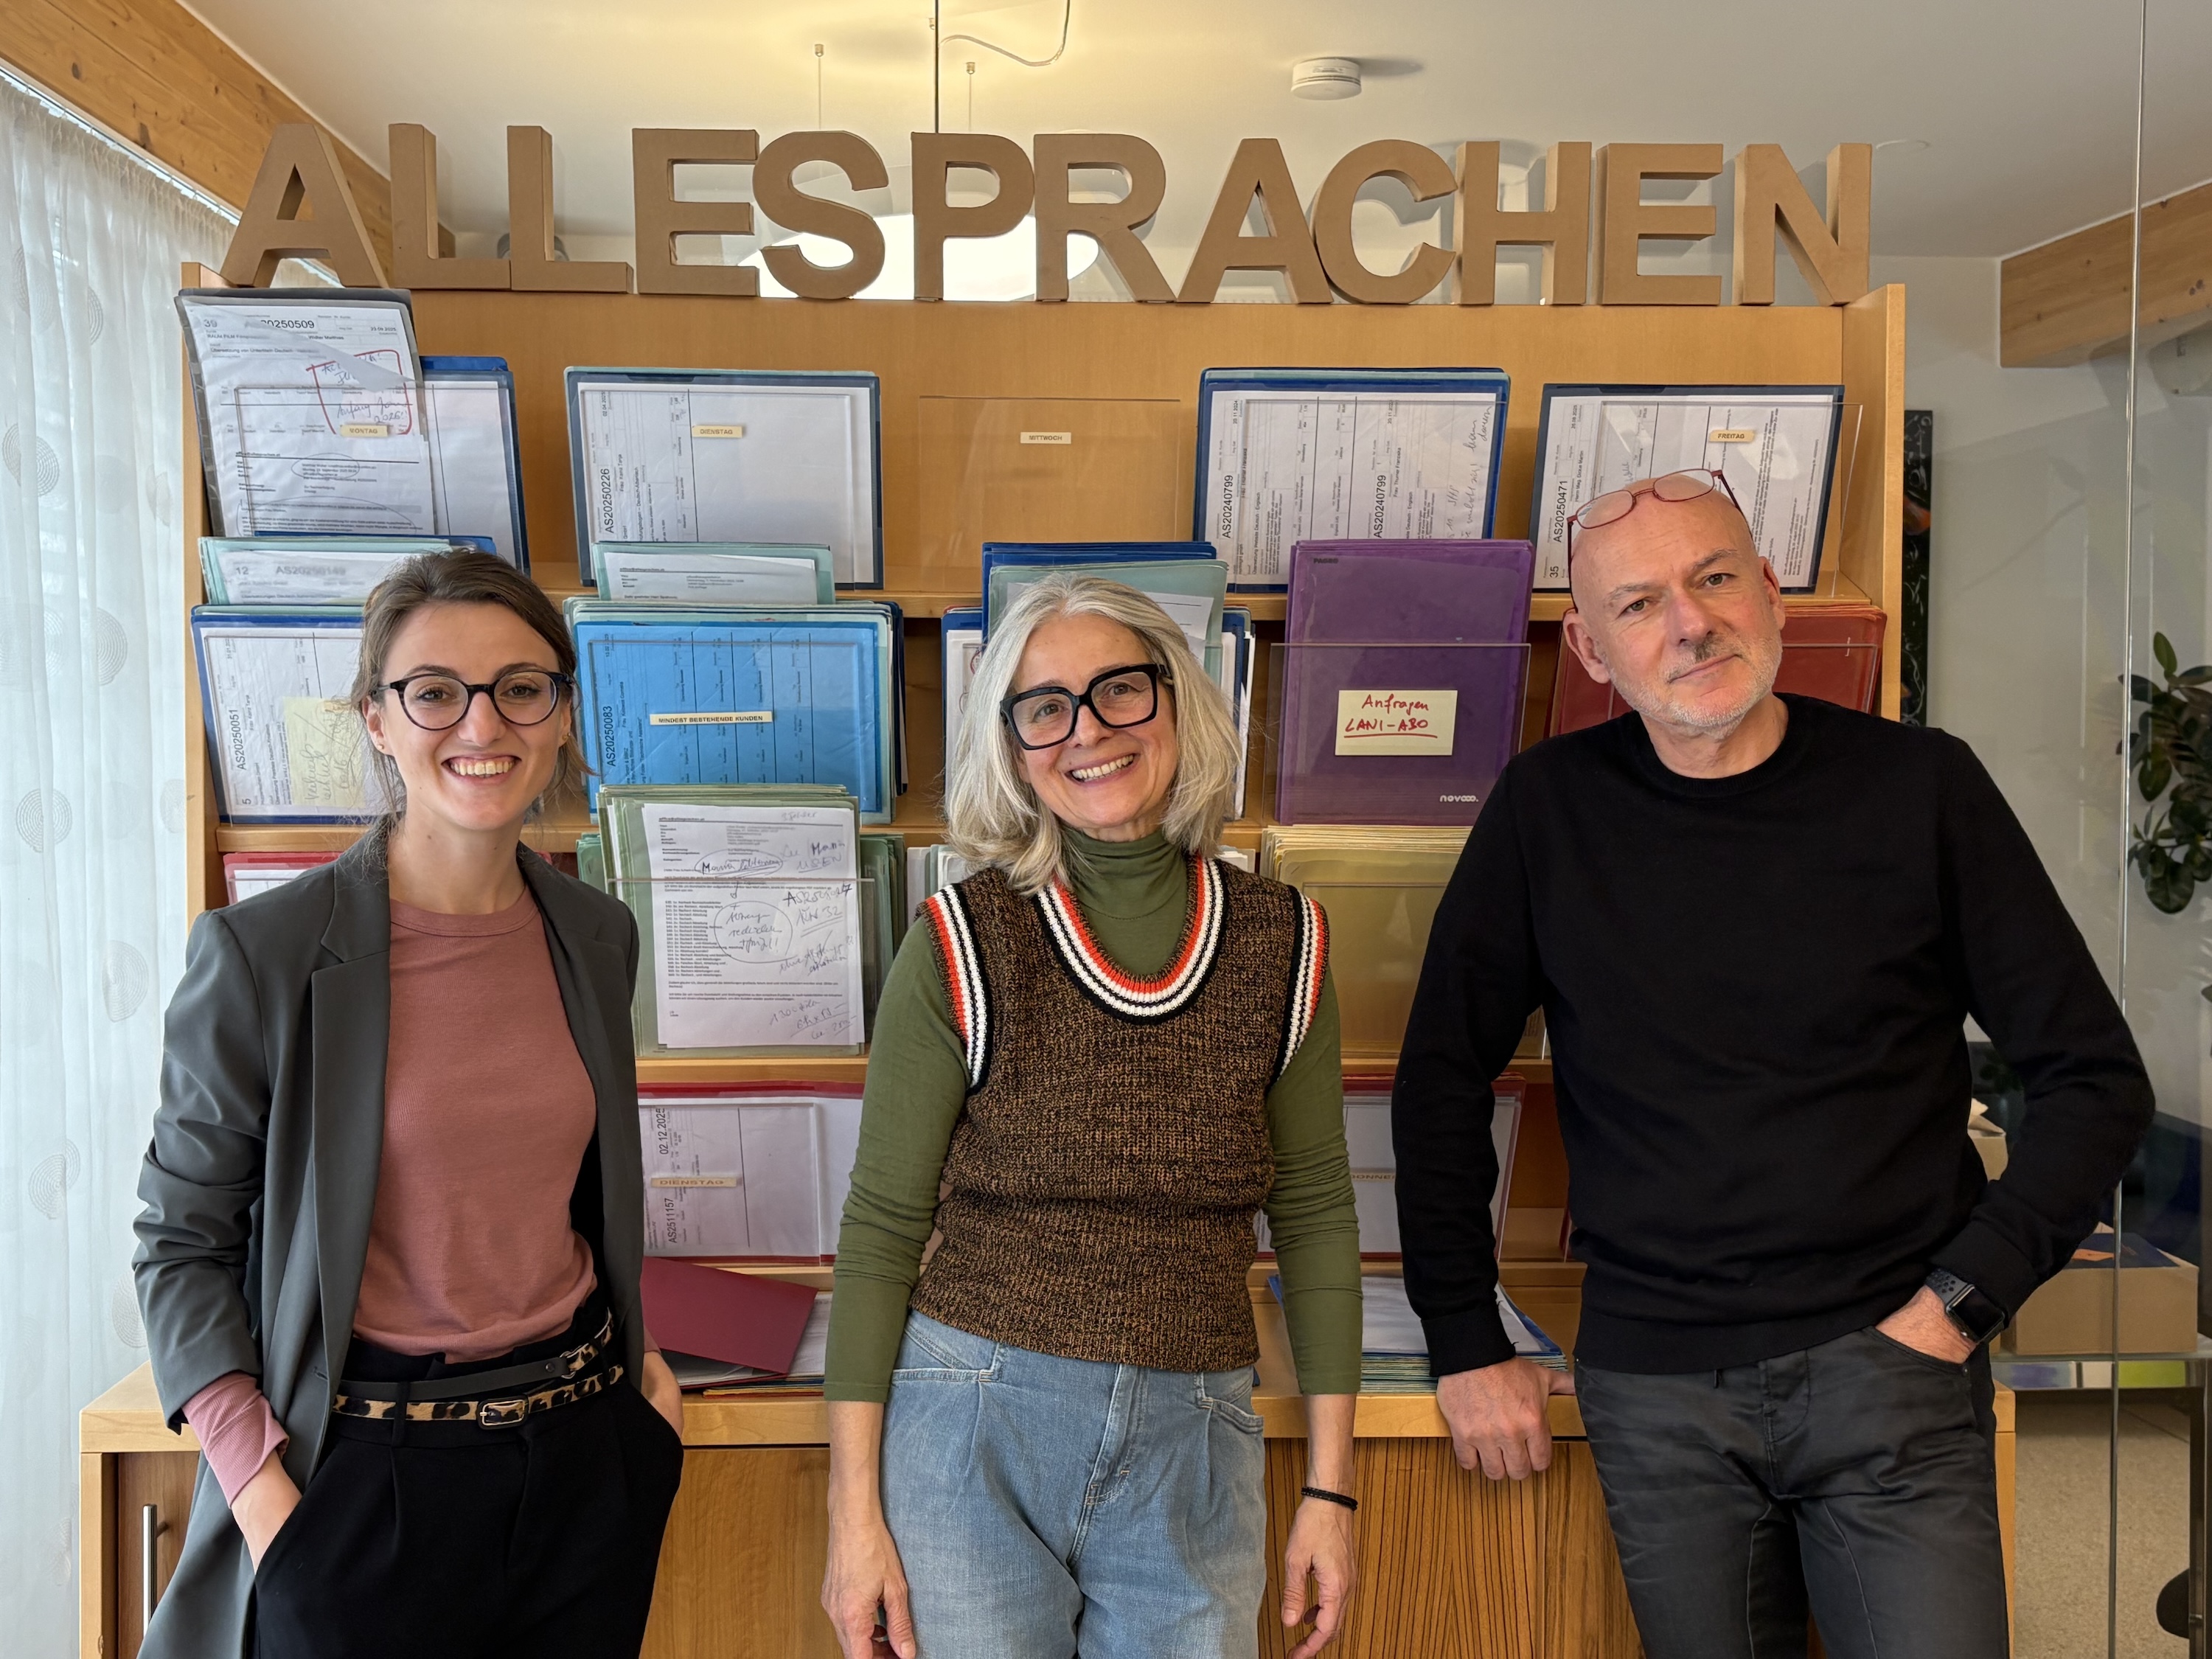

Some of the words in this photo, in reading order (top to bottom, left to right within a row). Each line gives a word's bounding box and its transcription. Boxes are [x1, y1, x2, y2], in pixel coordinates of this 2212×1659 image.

[220, 123, 1872, 305] ALLESPRACHEN
[204, 319, 218, 328] 39
[600, 468, 615, 534] AS20250226
[1222, 475, 1234, 538] AS20240799
[1374, 475, 1386, 538] AS20240799
[1553, 480, 1568, 543] AS20250471
[236, 566, 249, 575] 12
[1550, 566, 1559, 578] 35
[1361, 694, 1429, 714] Anfragen
[229, 709, 246, 771] AS20250051
[603, 706, 616, 767] AS20250083
[655, 1108, 669, 1155] 02.12.2025
[664, 1197, 678, 1243] AS2511157
